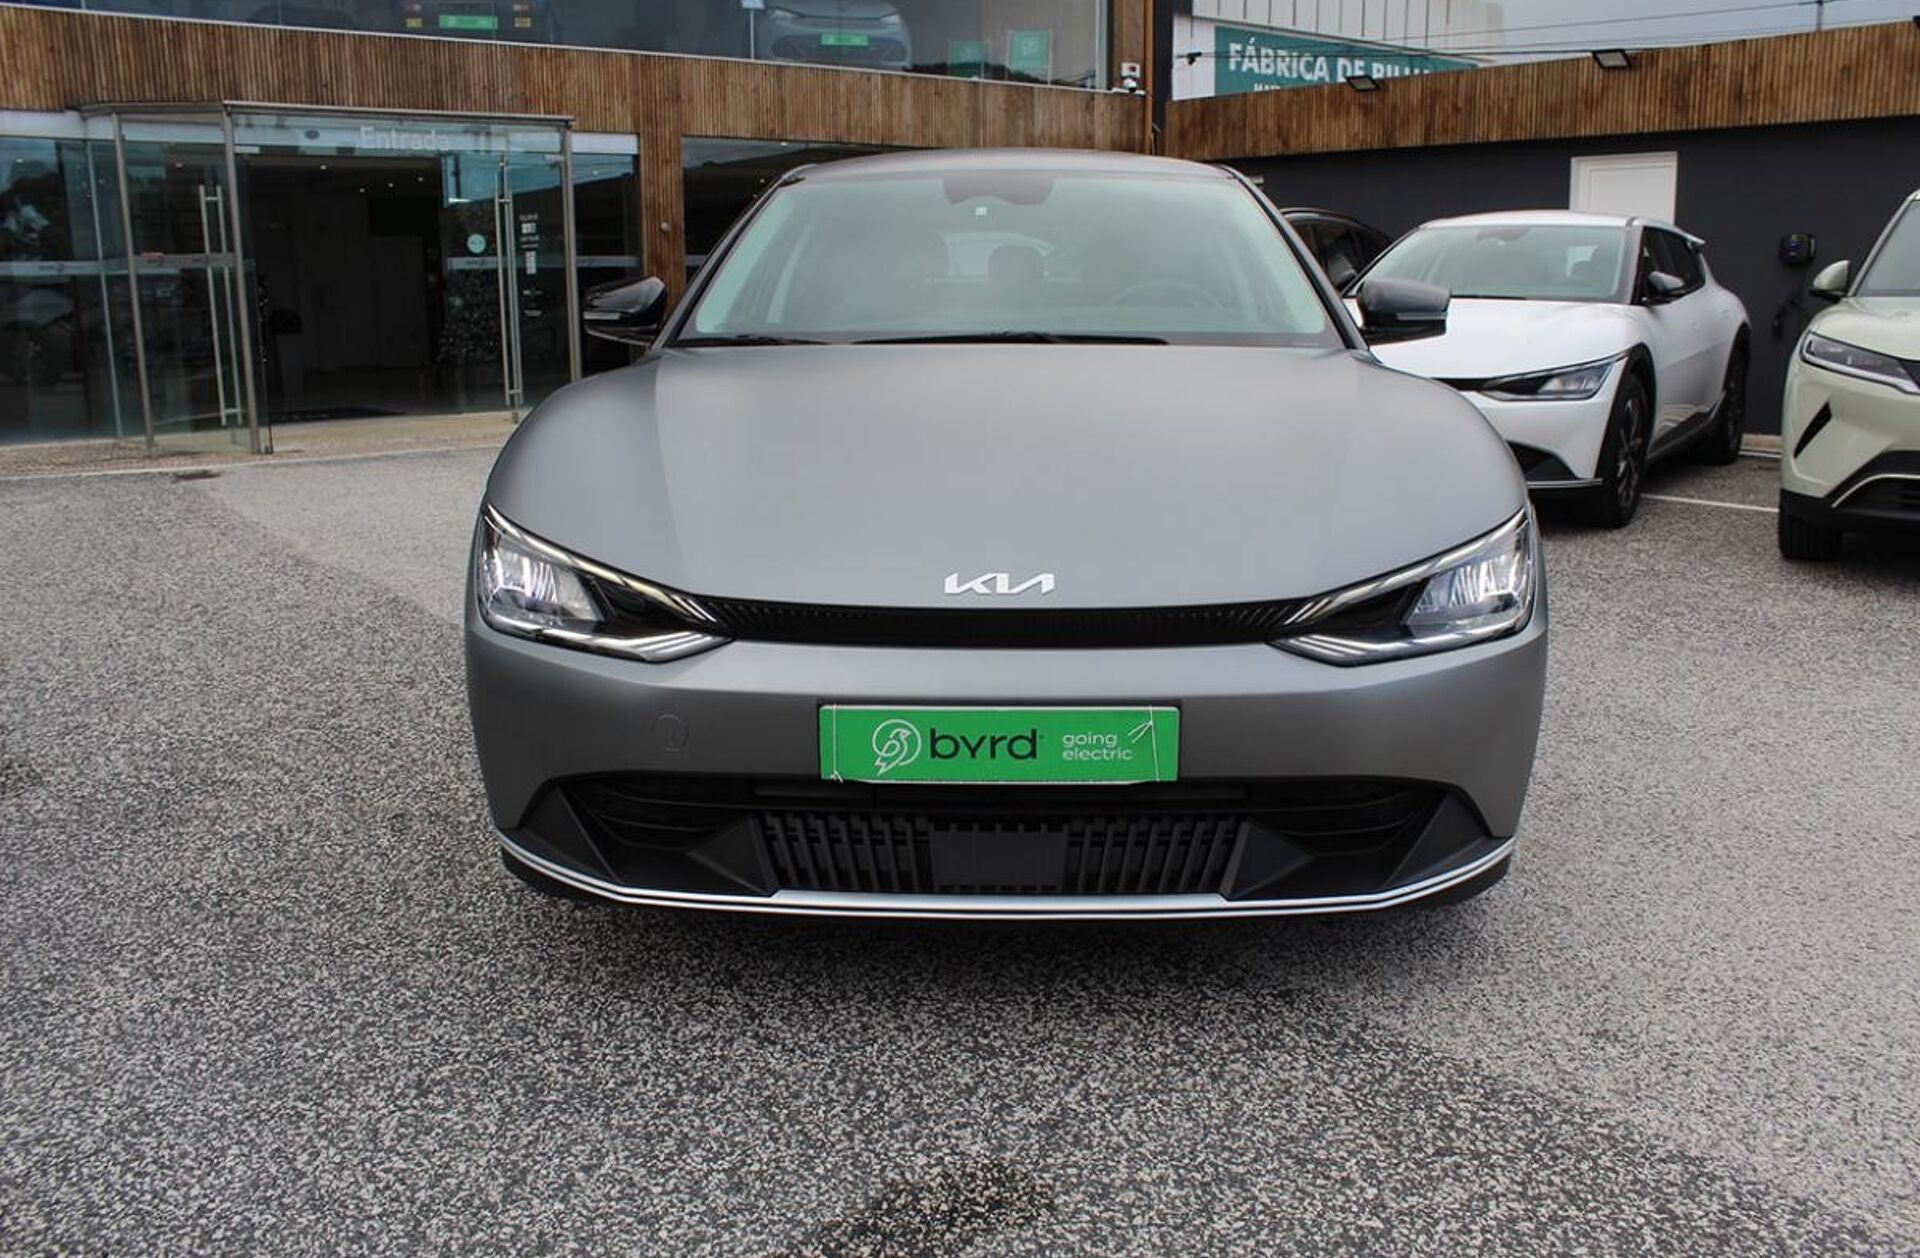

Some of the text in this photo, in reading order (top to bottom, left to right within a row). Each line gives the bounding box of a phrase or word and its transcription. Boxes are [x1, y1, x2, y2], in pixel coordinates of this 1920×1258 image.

[1228, 37, 1330, 83] FÁBRICA
[361, 127, 449, 151] Entrada
[944, 572, 1055, 594] KIA
[930, 728, 1037, 759] byrd
[1062, 733, 1118, 748] going
[1062, 748, 1133, 760] electric
